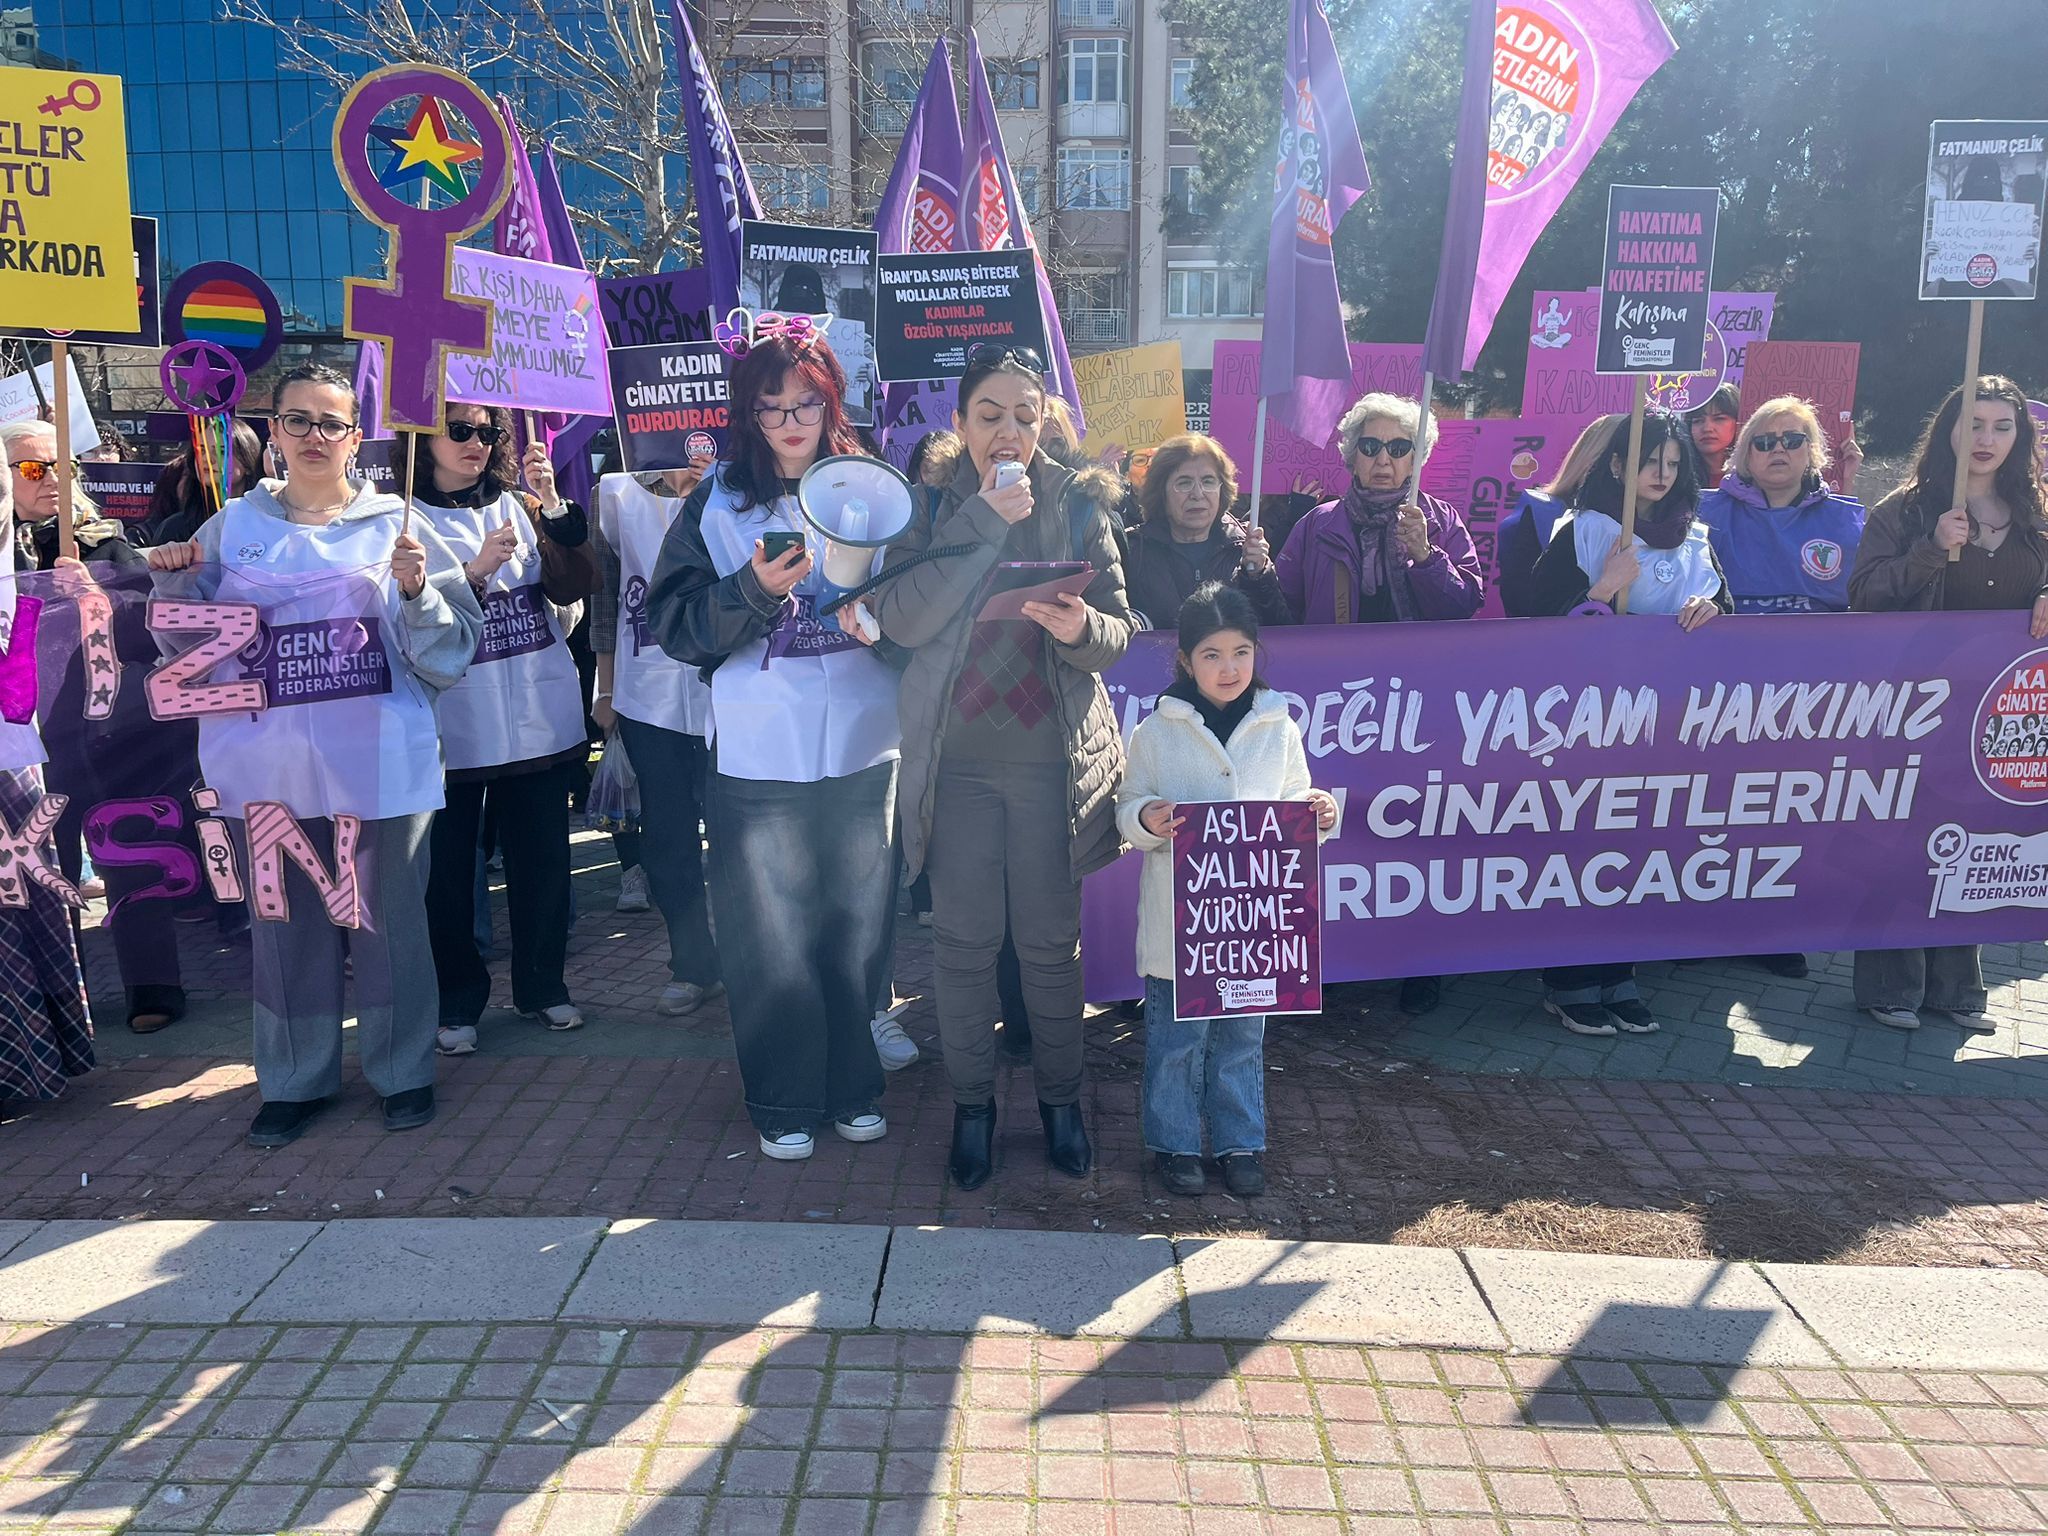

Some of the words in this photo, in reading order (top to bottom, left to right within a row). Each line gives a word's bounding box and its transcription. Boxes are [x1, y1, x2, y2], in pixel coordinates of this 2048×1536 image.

[1496, 12, 1579, 75] ADIN
[1494, 47, 1579, 109] ETLERİNİ
[1938, 139, 2007, 157] FATMANUR
[2009, 134, 2045, 157] ÇELİK
[1617, 210, 1703, 235] HAYATIMA
[749, 243, 828, 264] FATMANUR
[829, 245, 871, 268] ÇELİK
[1616, 240, 1698, 265] HAKKIMA
[879, 267, 931, 285] İRAN'DA
[931, 266, 970, 284] SAVAŞ
[971, 263, 1020, 280] BİTECEK
[1607, 266, 1705, 293] KIYAFETİME
[478, 266, 516, 304] KİŞİ
[520, 275, 569, 312] DAHA
[604, 281, 682, 321] YOK
[895, 287, 960, 303] MOLLALAR
[960, 283, 1012, 300] GİDECEK
[494, 308, 551, 342] MEYE
[924, 304, 985, 320] KADINLAR
[1614, 295, 1688, 335] Karışma
[903, 323, 944, 340] ÖZGÜR
[946, 321, 1014, 341] YAŞAYACAK
[660, 353, 722, 378] KADIN
[626, 407, 729, 434] DURDURAC
[128, 482, 142, 493] VE
[143, 480, 157, 494] Hİ
[277, 651, 385, 680] FEMİNİSTLER
[278, 671, 377, 697] FEDERASYONU
[1455, 683, 1659, 768] YAŞAM
[1677, 678, 1951, 752] HAKKIMIZ
[1988, 761, 2048, 779] DURDURA
[1366, 753, 1922, 839] CİNAYETLERİNİ
[1202, 804, 1284, 845] ASLA
[1969, 843, 2022, 863] GENÇ
[1186, 848, 1305, 894] YALNIZ
[1324, 832, 1803, 922] RDURACAĞIZ
[1964, 863, 2048, 885] FEMİNİST
[1960, 885, 2048, 901] FEDERASYON
[1184, 893, 1305, 936] YÜRÜME-
[1230, 989, 1274, 999] FEMİNİSTLER
